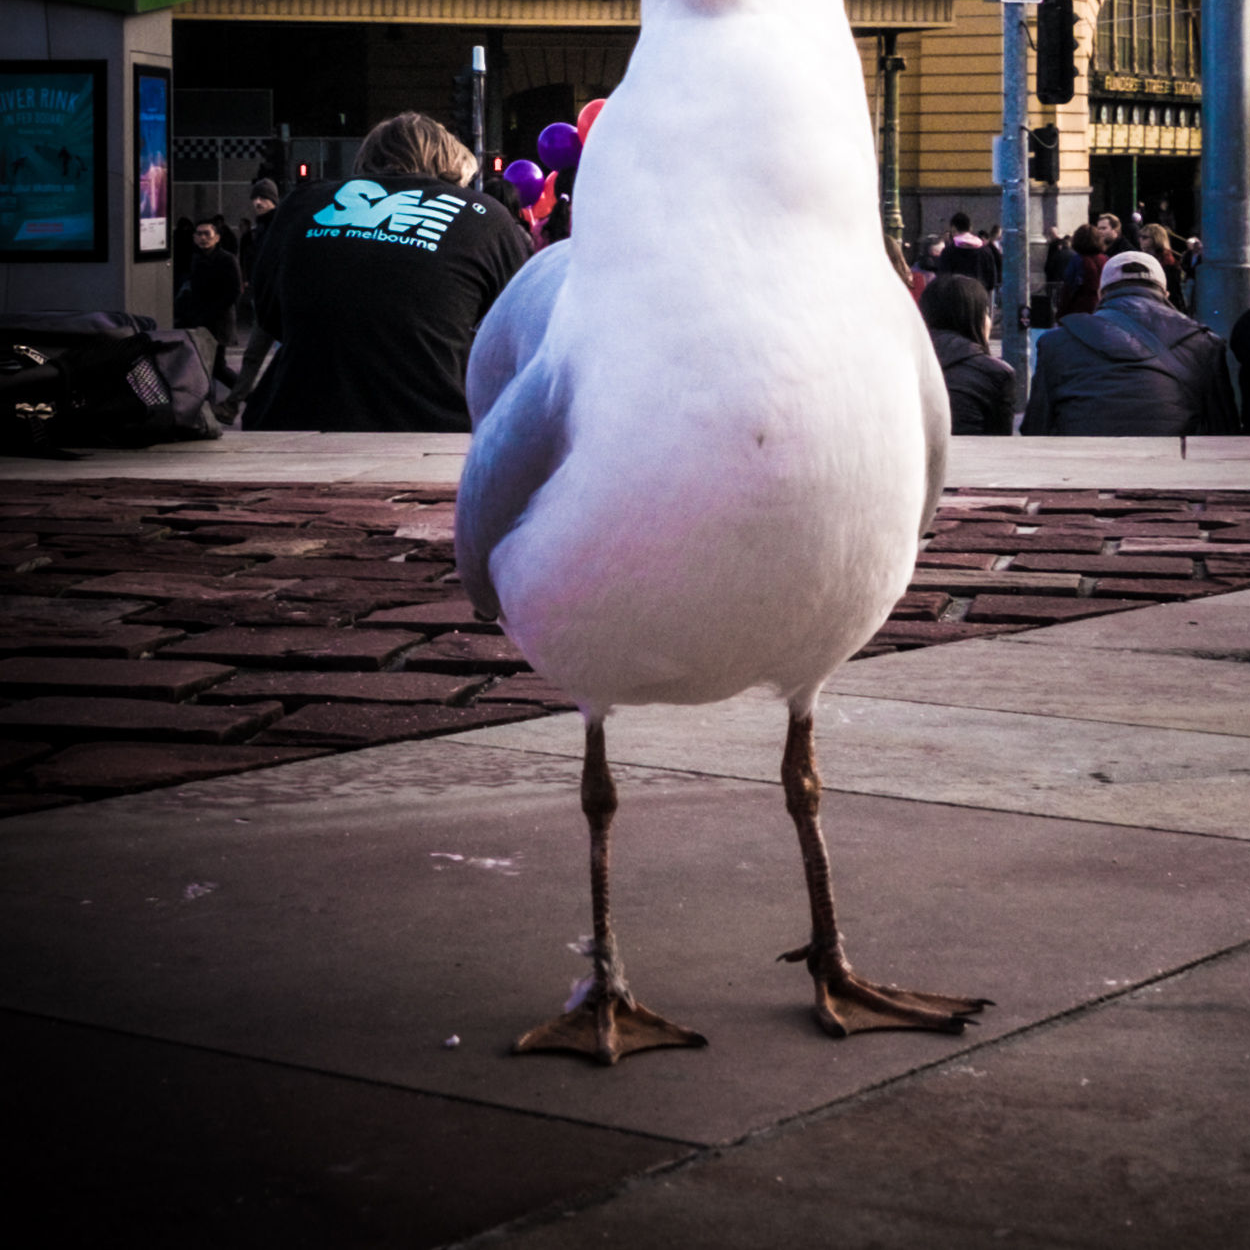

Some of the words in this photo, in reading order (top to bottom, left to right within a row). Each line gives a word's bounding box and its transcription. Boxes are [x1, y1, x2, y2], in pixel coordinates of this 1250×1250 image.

[40, 87, 80, 114] RINK
[305, 227, 341, 238] sure
[345, 228, 438, 252] melbourne
